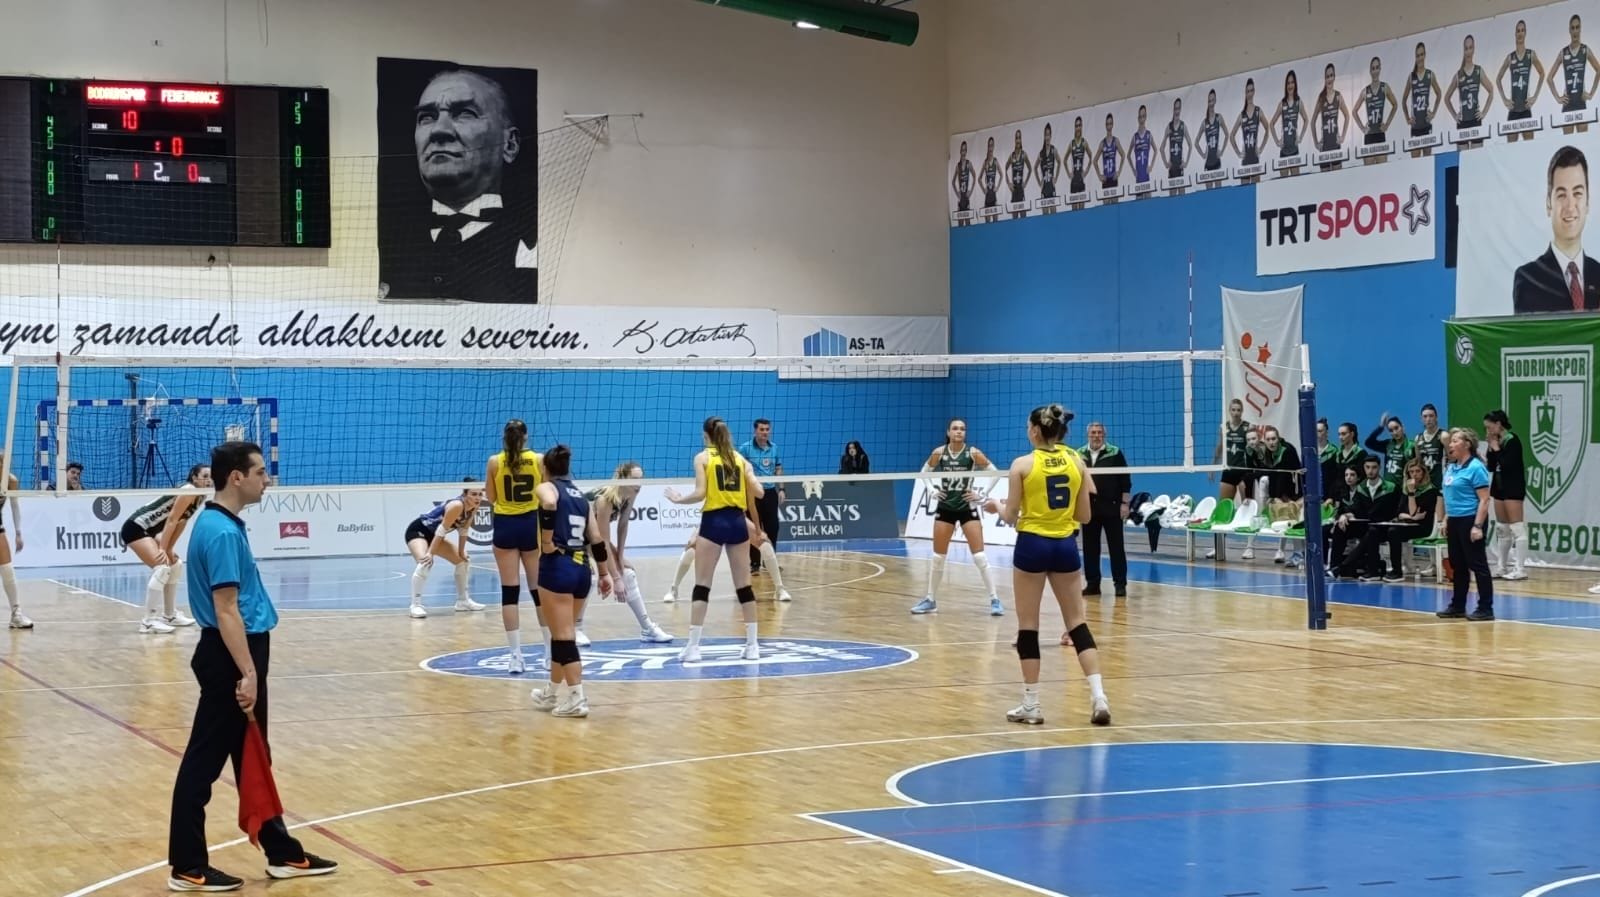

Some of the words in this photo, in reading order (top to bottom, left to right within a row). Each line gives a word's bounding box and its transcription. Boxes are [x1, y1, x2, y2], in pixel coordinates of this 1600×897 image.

[122, 110, 137, 129] 10
[153, 162, 163, 180] 2
[1260, 192, 1399, 247] TRTSPOR
[69, 313, 242, 355] zamanda
[258, 310, 447, 347] ahlaklısını
[460, 322, 589, 350] severim.
[849, 337, 885, 350] AS-TA
[1507, 358, 1586, 378] BODRUMSPOR
[1527, 466, 1541, 489] 19
[503, 474, 534, 503] 12
[1045, 474, 1071, 510] 6
[628, 506, 658, 521] ore
[662, 508, 702, 519] conce
[567, 514, 586, 546] 3
[790, 524, 818, 539] ÇELİK
[820, 524, 844, 536] KAPI
